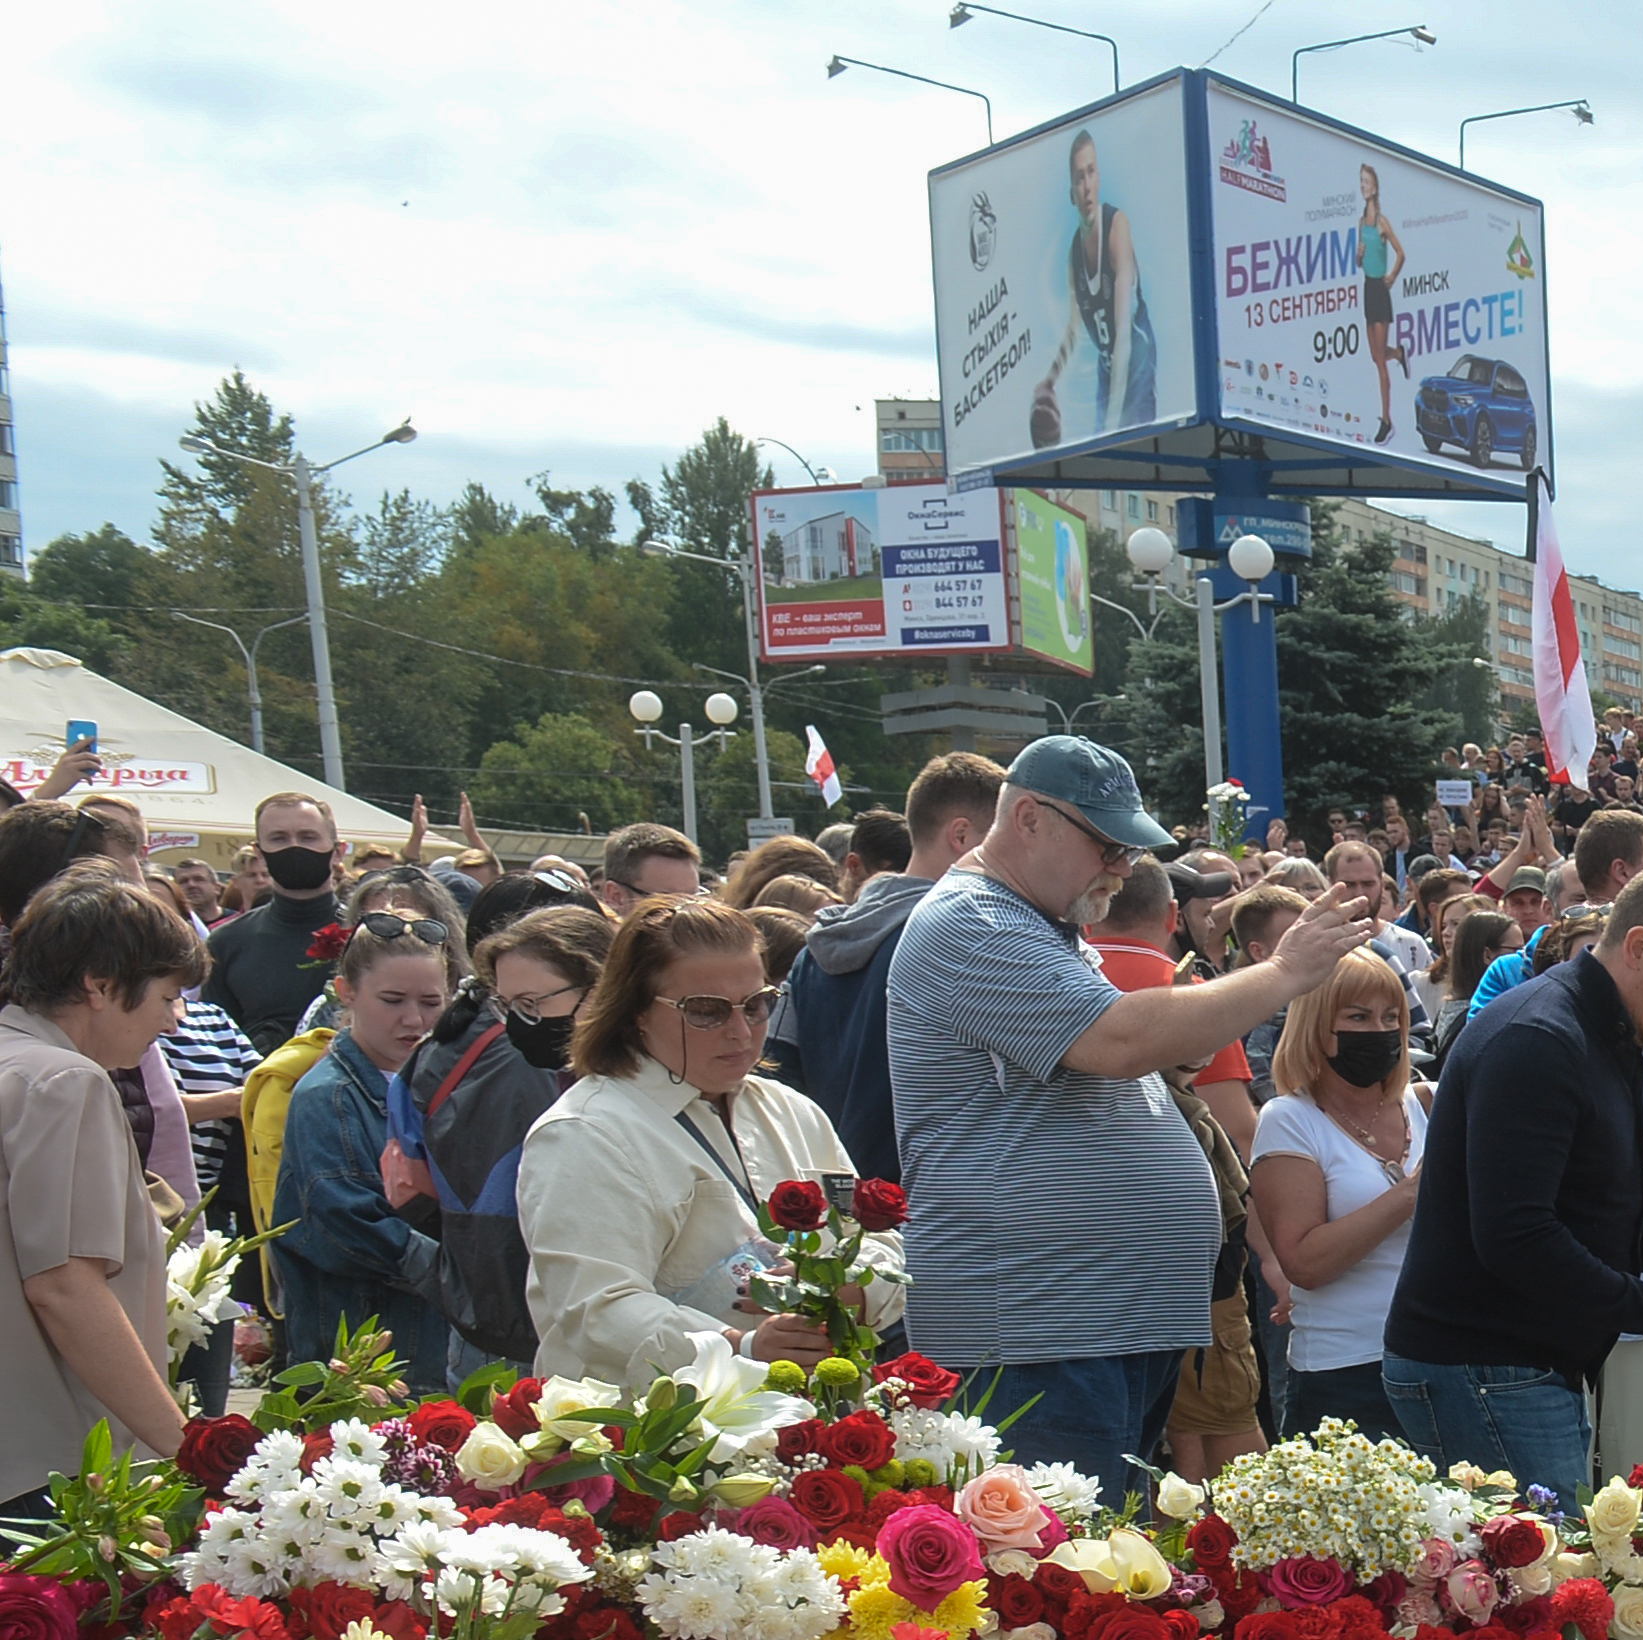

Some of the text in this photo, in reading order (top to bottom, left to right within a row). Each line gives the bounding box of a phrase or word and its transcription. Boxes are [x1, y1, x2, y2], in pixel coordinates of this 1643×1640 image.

[1226, 227, 1357, 298] БЕЖИМ
[1403, 270, 1450, 298] МИНСК
[968, 276, 1009, 335] НАША
[1245, 284, 1359, 329] 13 СЕНТЯБРЯ
[1396, 288, 1524, 360] ВМЕСТЕ!
[1313, 323, 1360, 363] 9:00
[954, 329, 1032, 428] БАСКЕТБОЛ!
[908, 509, 966, 520] ОкнаСервис
[896, 560, 986, 575] ПРОИЗВОДЯТ У НАС
[901, 546, 979, 560] ОКНА БУДУЩЕГО
[934, 581, 952, 592] 664
[955, 580, 967, 592] 57
[970, 579, 983, 591] 67
[935, 598, 953, 609] 844
[956, 596, 968, 608] 57
[970, 595, 983, 607] 67
